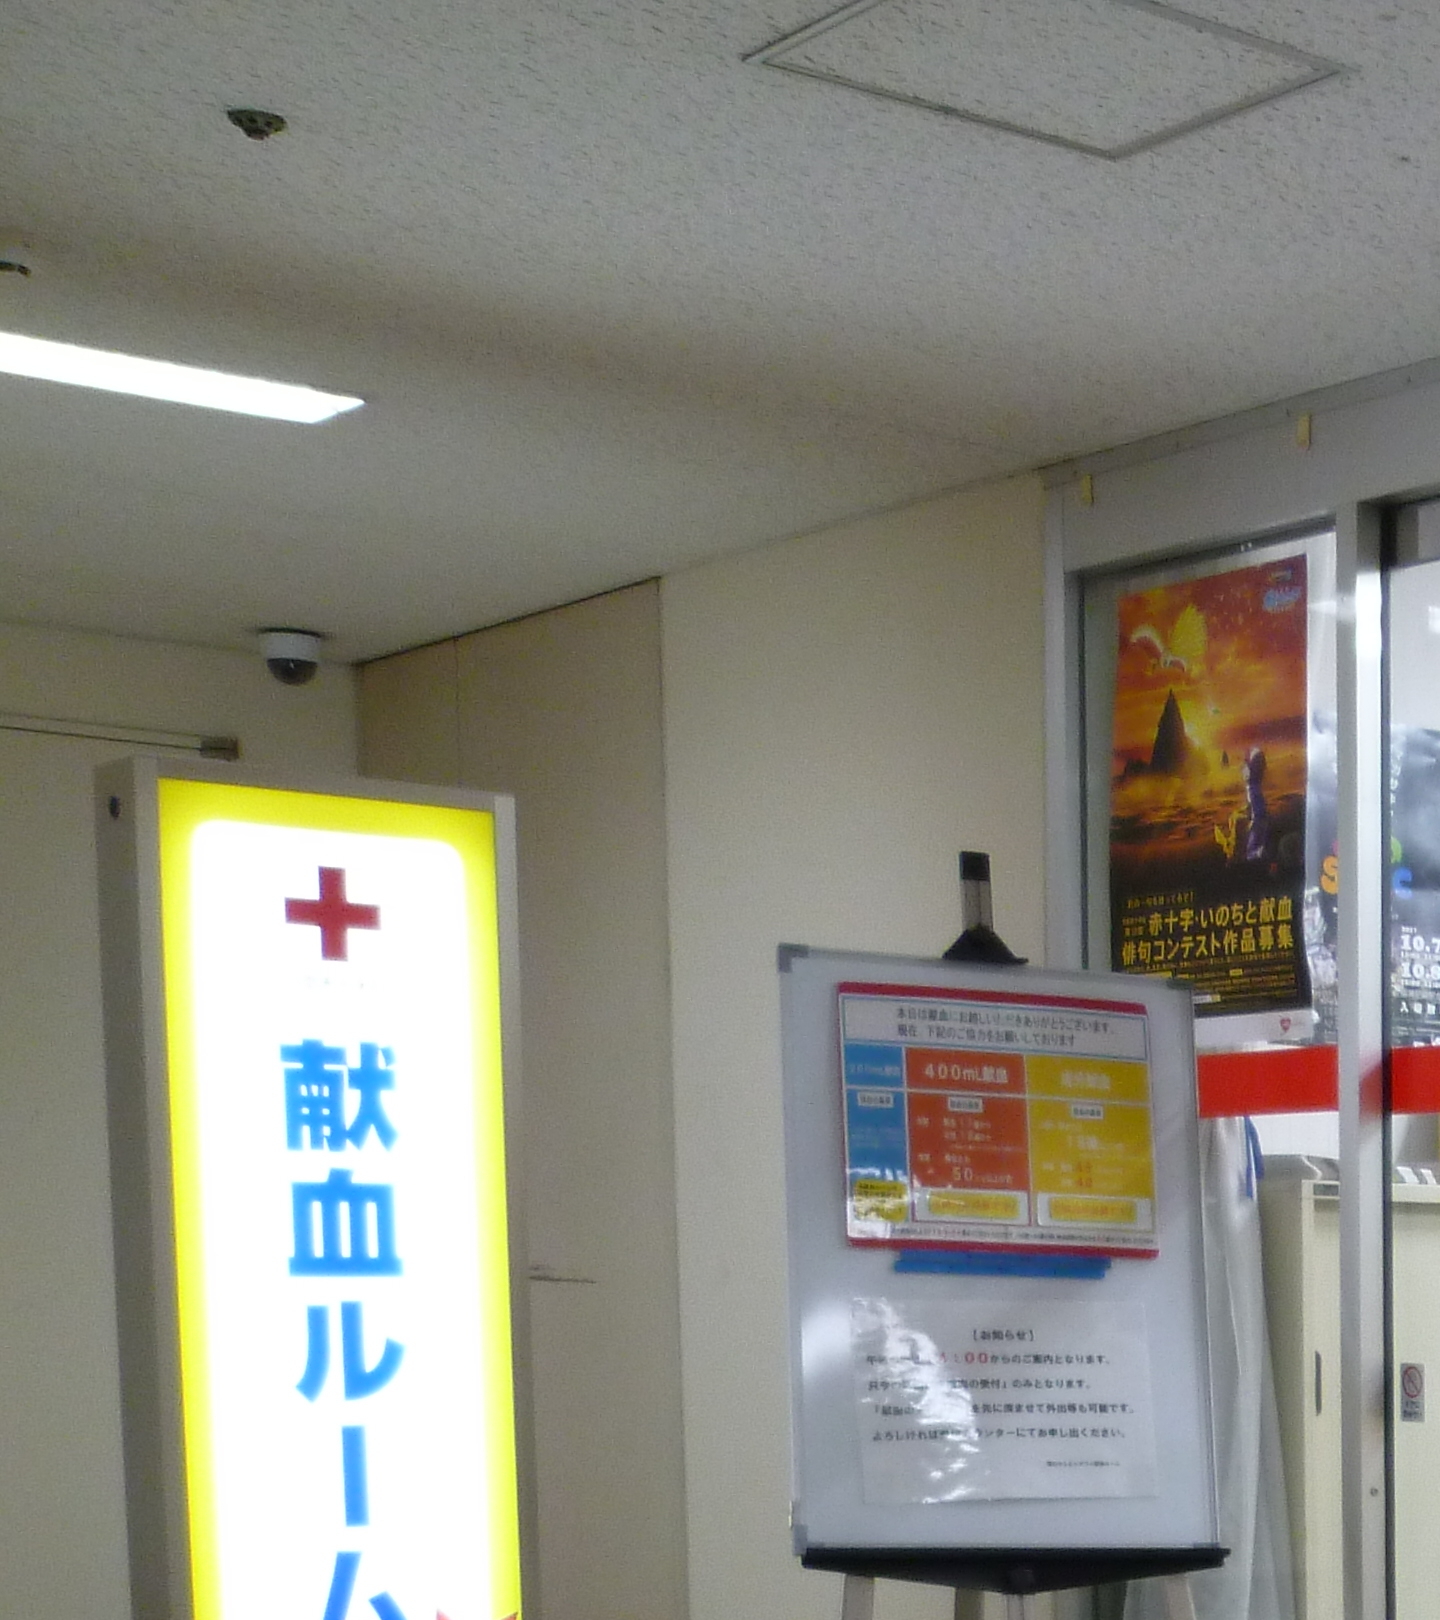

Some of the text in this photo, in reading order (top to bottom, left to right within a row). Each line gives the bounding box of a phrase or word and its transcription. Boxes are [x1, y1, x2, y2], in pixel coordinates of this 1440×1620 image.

[1122, 922, 1293, 966] 俳句コンテスト作品募集
